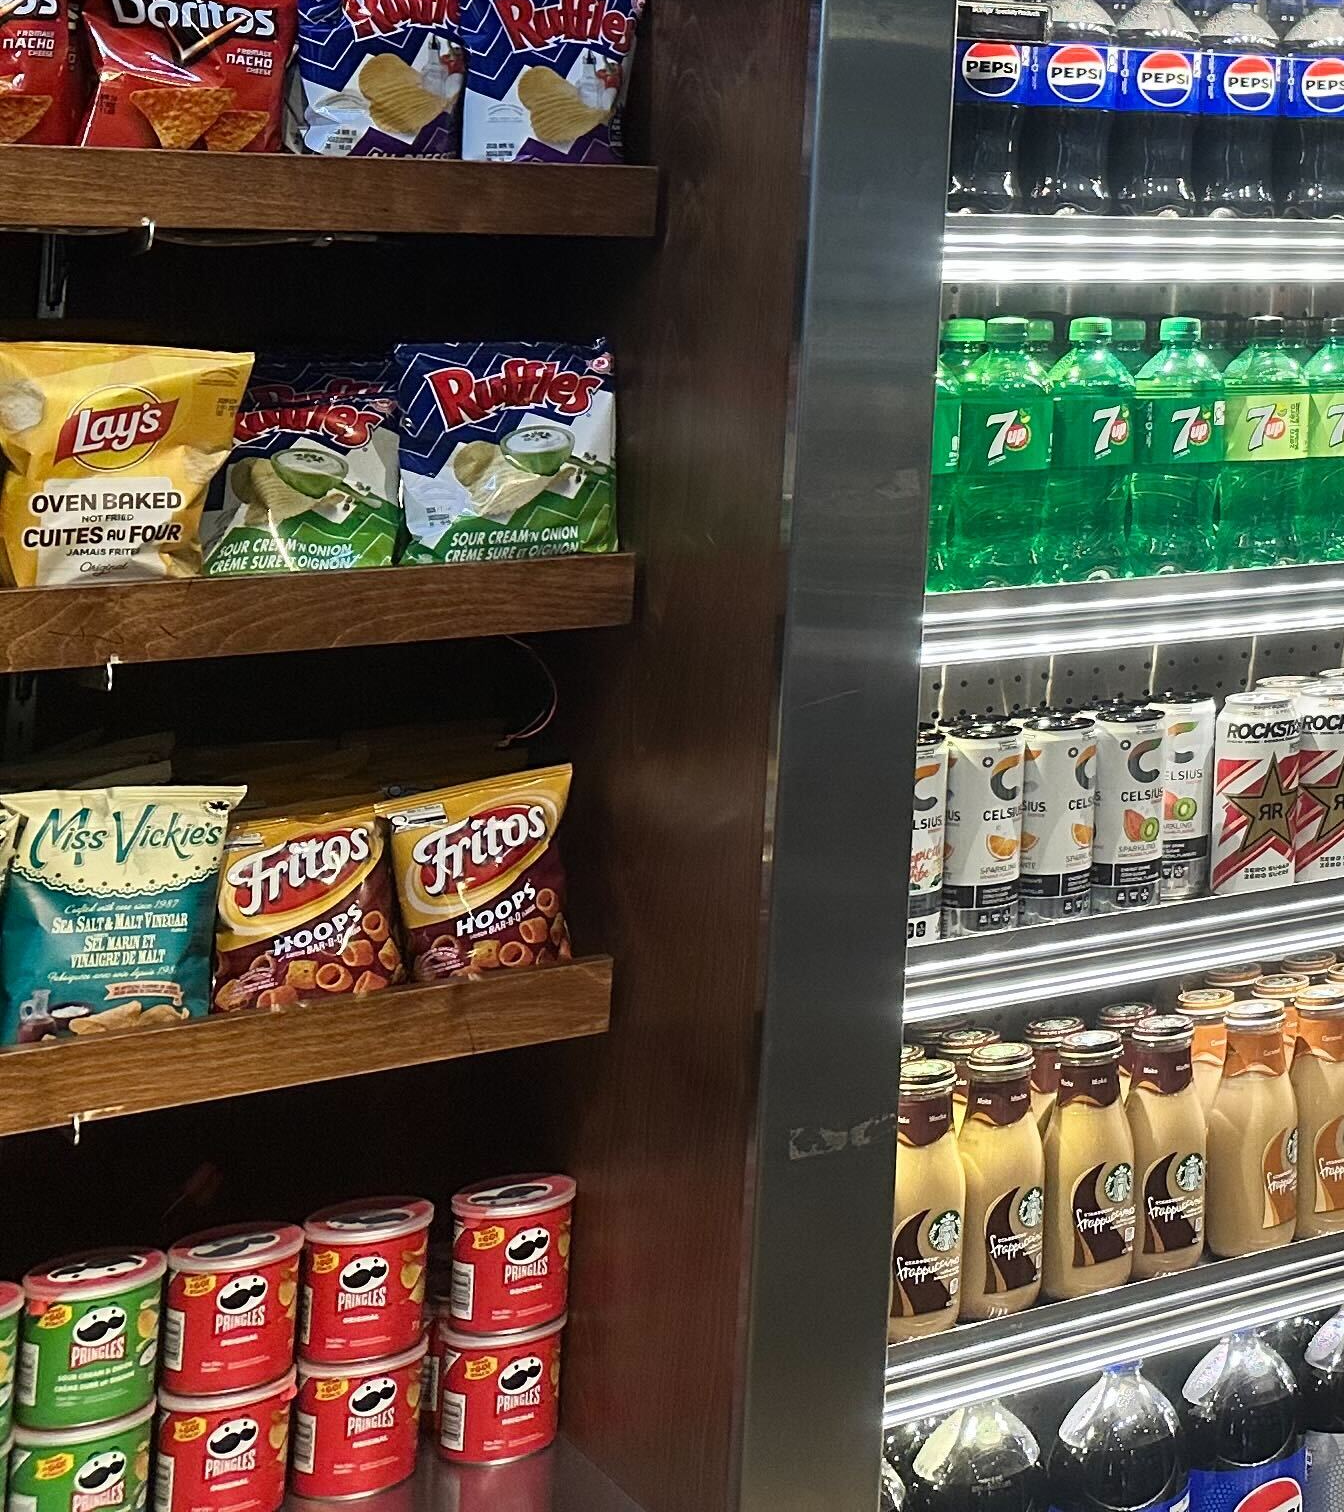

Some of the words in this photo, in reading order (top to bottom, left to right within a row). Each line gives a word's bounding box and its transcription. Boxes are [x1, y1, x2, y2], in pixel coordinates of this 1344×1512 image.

[966, 60, 1018, 75] PEPSI
[1051, 66, 1102, 80] PEPSI
[1141, 72, 1190, 85] PEPSI
[1228, 76, 1273, 89] PEPSI
[423, 357, 605, 433] Ruffles
[31, 493, 97, 514] OVEN
[100, 491, 183, 511] BAKED
[82, 514, 103, 524] NOT
[105, 513, 134, 524] FRIED
[23, 526, 104, 548] CUITES
[106, 530, 126, 543] AU
[129, 523, 182, 544] FOUR
[450, 530, 486, 548] SOUR
[488, 528, 528, 544] CREAM
[540, 525, 579, 541] ONION
[66, 547, 107, 557] JAMAIS
[219, 539, 250, 557] SOUR
[445, 545, 484, 564] CRÈME
[485, 547, 515, 562] SURE
[528, 541, 580, 559] OIGNON
[79, 560, 129, 576] Original
[250, 552, 286, 570] SURE
[1227, 720, 1300, 741] ROCKSTA
[29, 806, 110, 870] Miss
[112, 803, 224, 865] Vickie's
[412, 804, 547, 896] Fritos
[226, 826, 370, 916] Fritos
[456, 882, 537, 938] HOOPS
[52, 916, 74, 934] SEA
[75, 915, 104, 934] SALT
[104, 918, 115, 932] &
[115, 912, 143, 931] MALT
[144, 911, 188, 929] VINEGAR
[272, 902, 363, 957] HOOPS
[83, 934, 107, 953] SEL
[107, 933, 141, 951] MARIN
[142, 934, 156, 949] ET
[71, 950, 121, 969] VINAIGRE
[121, 951, 136, 966] DE
[138, 948, 166, 965] MALT
[505, 1256, 549, 1284] PRINGLES
[337, 1287, 387, 1312] PRINGLES
[215, 1306, 266, 1335] PRINGLES
[70, 1337, 125, 1368] PRINGLES
[496, 1386, 541, 1415] PRINGLES
[347, 1409, 395, 1438] PRINGLES
[205, 1448, 256, 1479] PRINGLES
